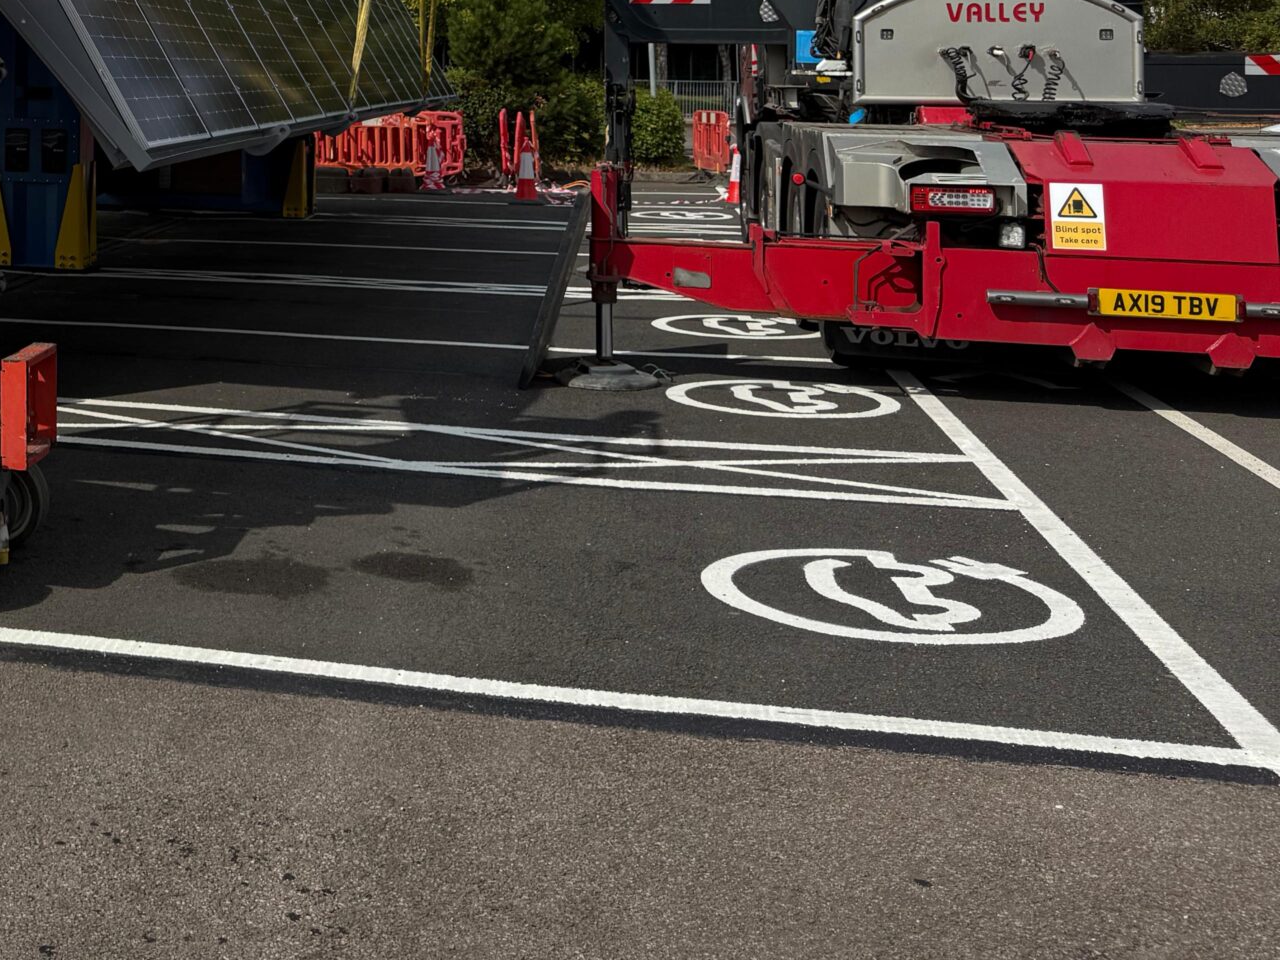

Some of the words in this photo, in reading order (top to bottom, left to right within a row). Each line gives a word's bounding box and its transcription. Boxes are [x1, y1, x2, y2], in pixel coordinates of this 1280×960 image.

[946, 2, 1045, 23] VALLEY
[1055, 225, 1079, 234] Blind
[1081, 227, 1102, 235] spot
[1059, 236, 1079, 244] Take
[1113, 292, 1165, 314] AX19
[1172, 295, 1219, 317] TBV
